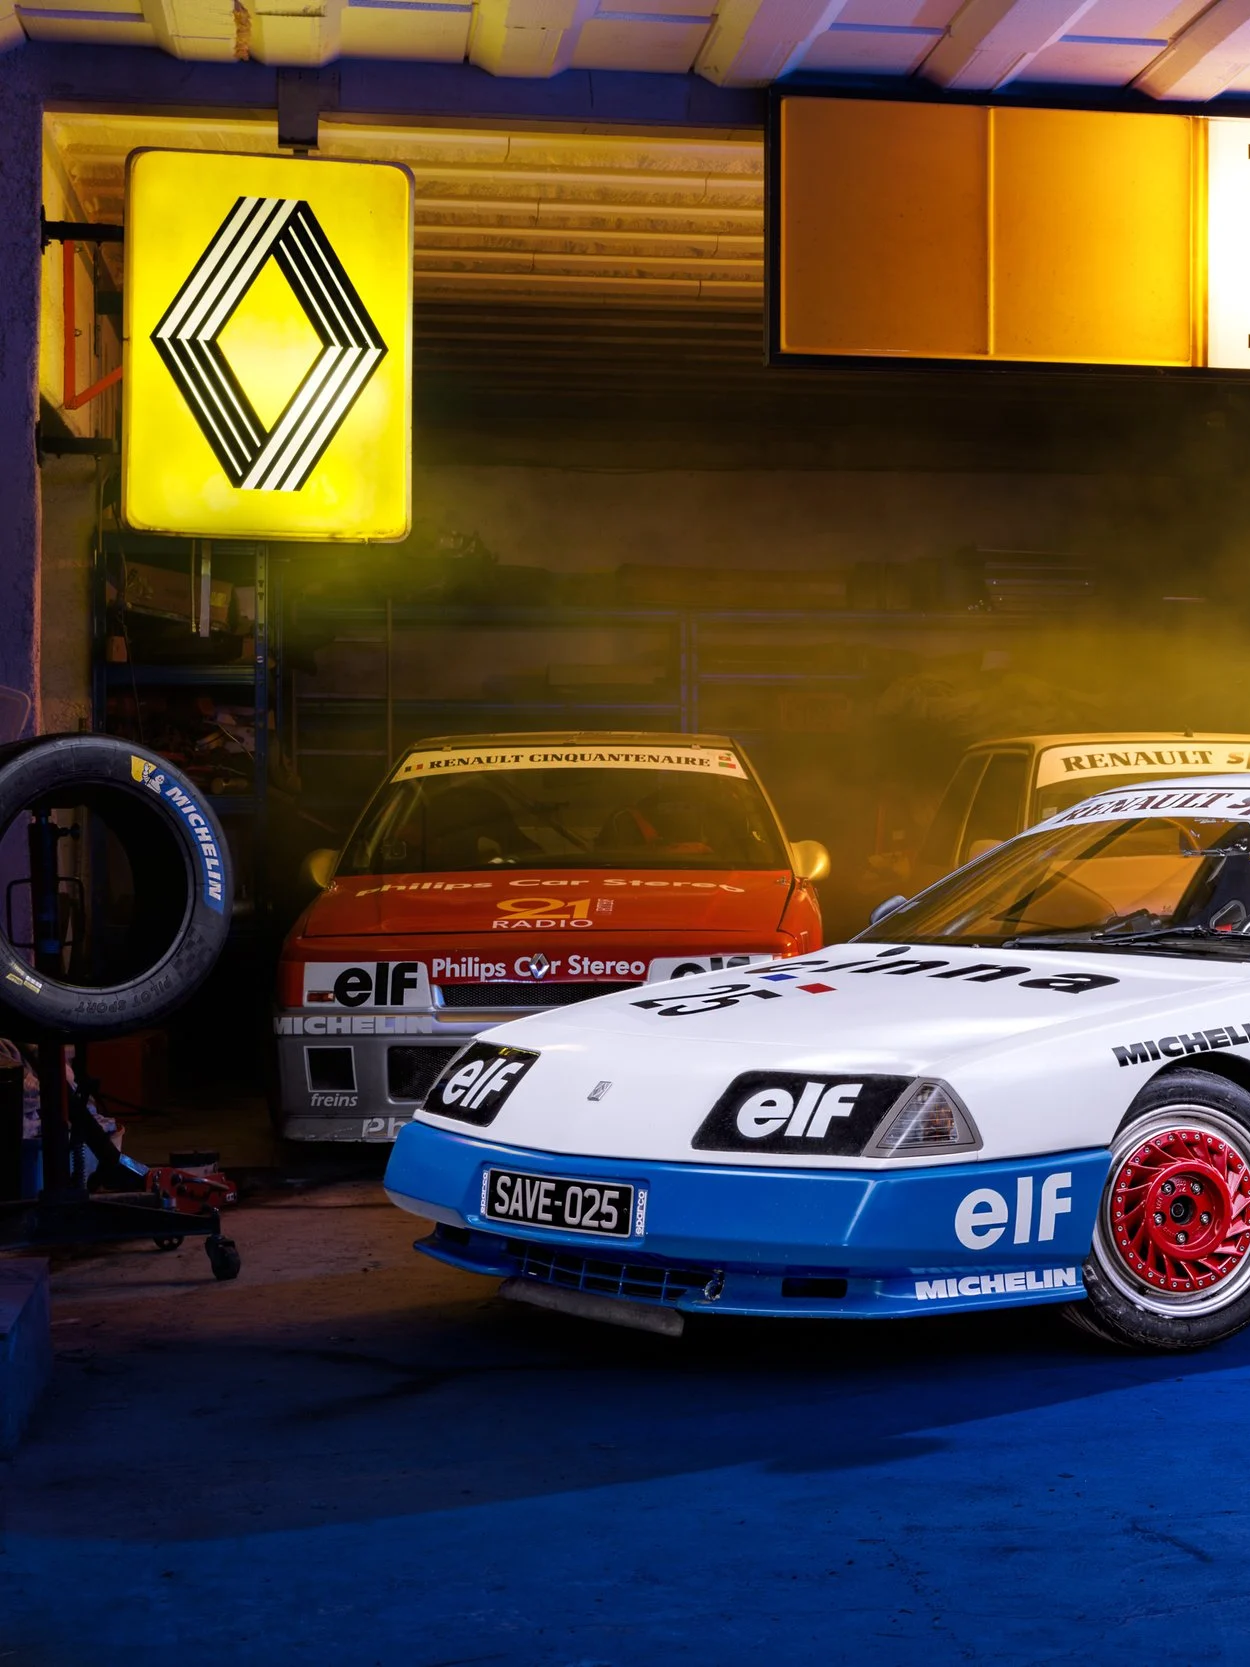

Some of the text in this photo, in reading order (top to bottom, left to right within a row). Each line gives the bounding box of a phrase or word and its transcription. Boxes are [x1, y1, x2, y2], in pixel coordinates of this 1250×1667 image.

[428, 752, 711, 770] RENAULT CINQUANTENAIRE
[1061, 749, 1213, 773] RENAULT
[1059, 792, 1236, 823] RENAULT
[165, 786, 222, 901] MICHELIN
[508, 878, 589, 887] Car
[603, 877, 745, 893] Stereo
[492, 919, 593, 929] RADIO
[496, 897, 593, 919] 21
[334, 962, 418, 1007] elf
[432, 955, 646, 982] Philips Cr Stereo
[74, 975, 171, 1014] PILOT SPORT
[630, 983, 784, 1017] 25
[273, 1016, 433, 1035] MICHELIN
[311, 1093, 358, 1107] freins
[442, 1058, 525, 1110] elf
[736, 1081, 863, 1139] elf
[494, 1175, 620, 1230] SAVE-025
[954, 1172, 1072, 1250] elf
[915, 1267, 1077, 1301] MICHELIN
